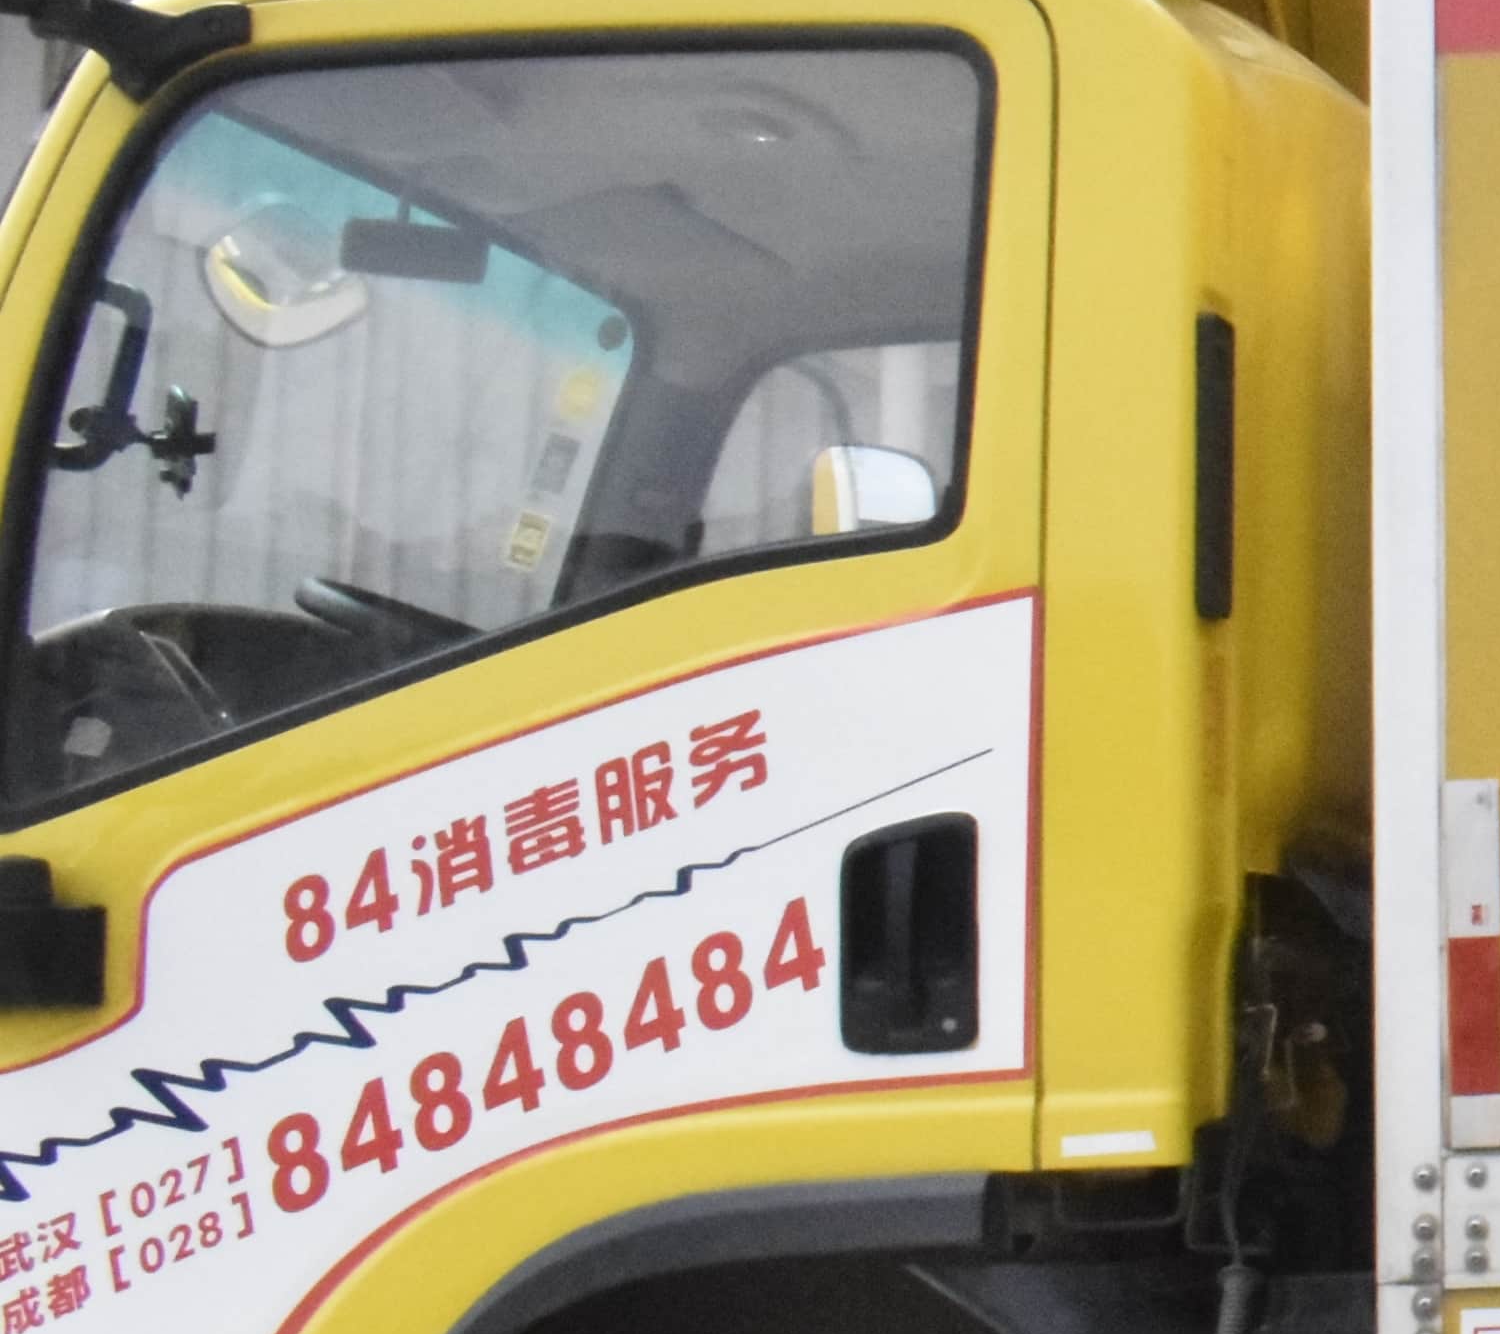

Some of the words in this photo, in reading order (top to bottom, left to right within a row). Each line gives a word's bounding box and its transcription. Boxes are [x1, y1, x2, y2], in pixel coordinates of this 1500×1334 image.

[282, 709, 768, 963] 84消毒服务
[268, 897, 825, 1214] 84848484
